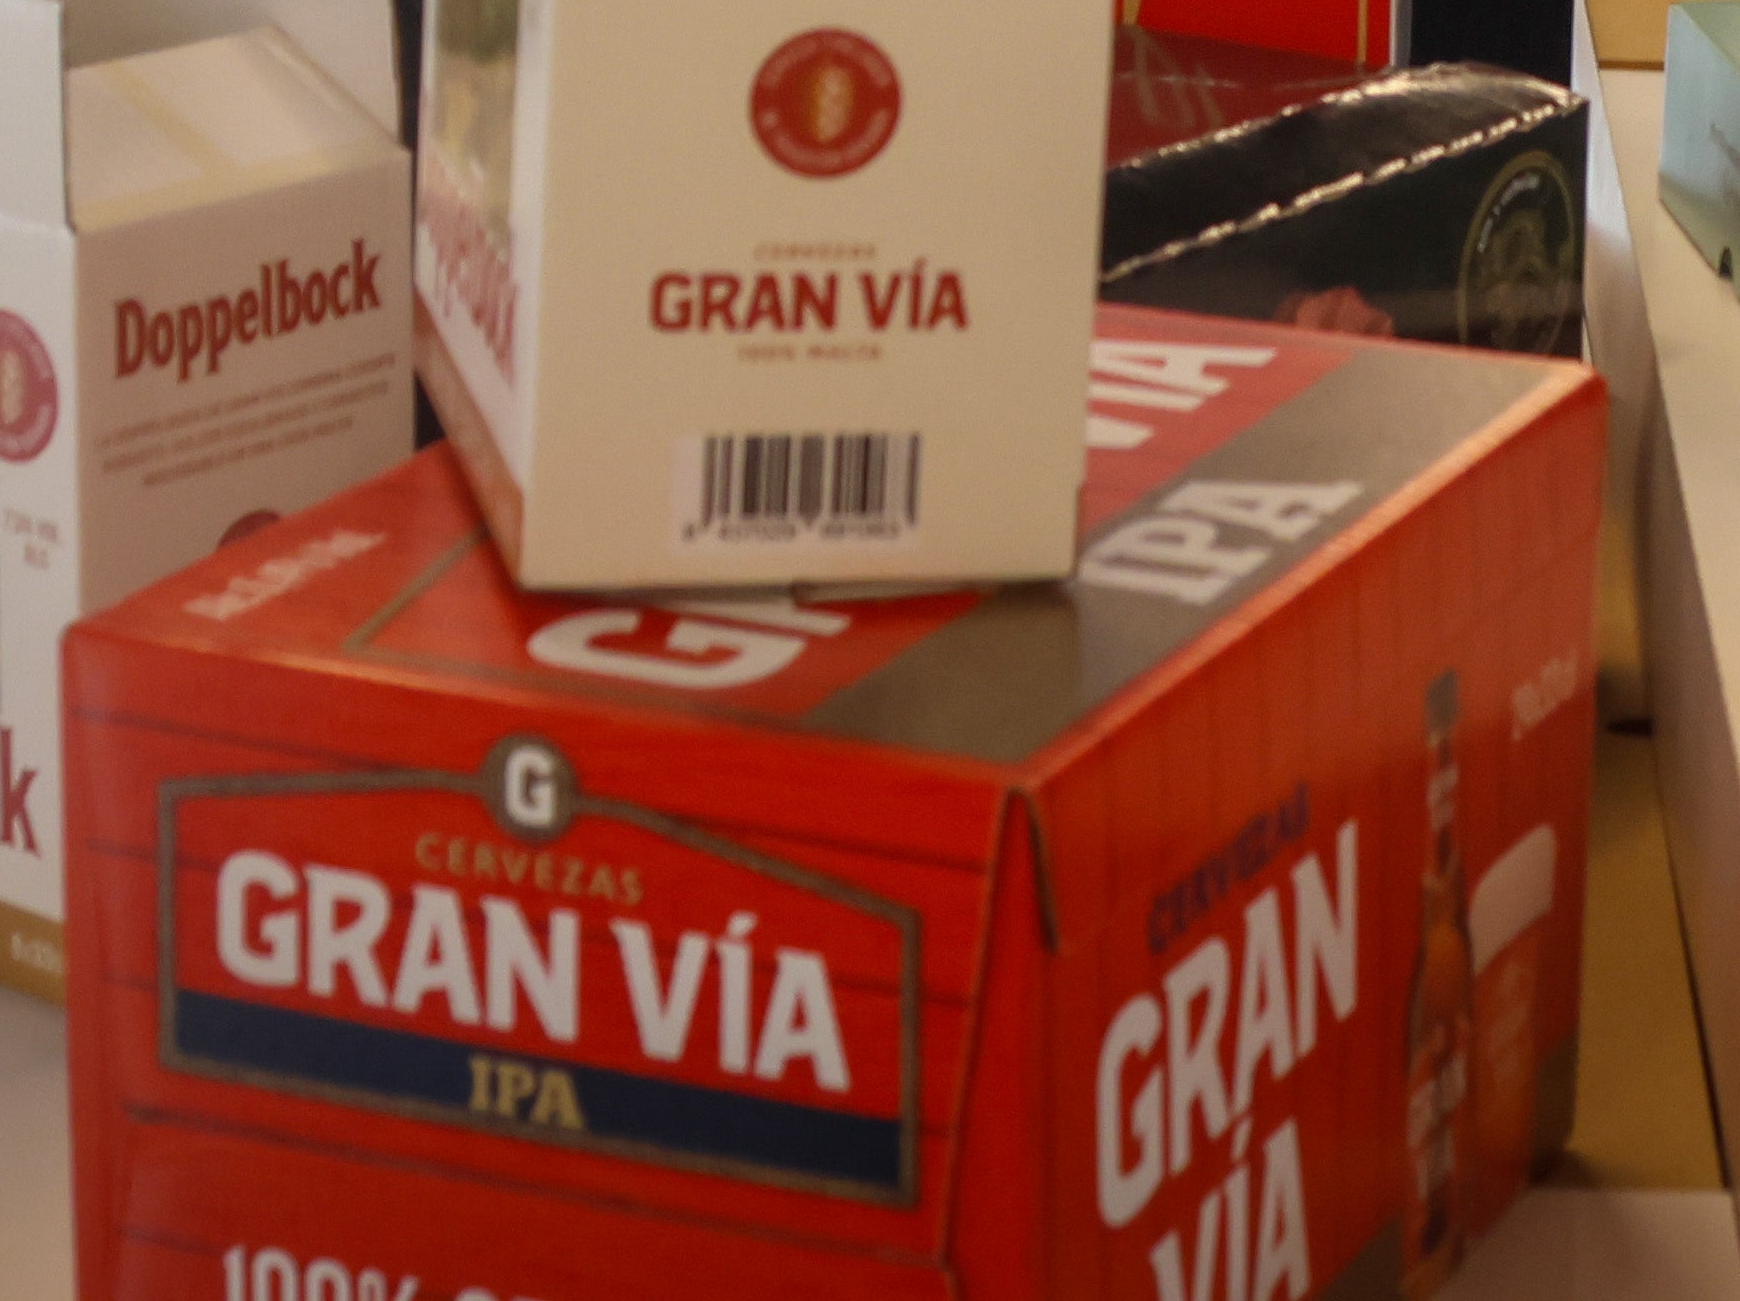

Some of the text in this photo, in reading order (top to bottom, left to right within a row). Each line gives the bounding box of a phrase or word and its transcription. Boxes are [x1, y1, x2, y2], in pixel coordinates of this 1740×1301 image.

[114, 237, 383, 386] Doppelbock
[649, 254, 969, 336] GRAN VÍA
[1075, 480, 1365, 606] IPA
[503, 747, 557, 830] G
[414, 831, 646, 909] CERVEZAS
[1149, 780, 1314, 957] CERVEZAS
[213, 849, 853, 1096] GRAN VÍA
[1095, 820, 1362, 1230] GRAN
[468, 1053, 587, 1132] IPA
